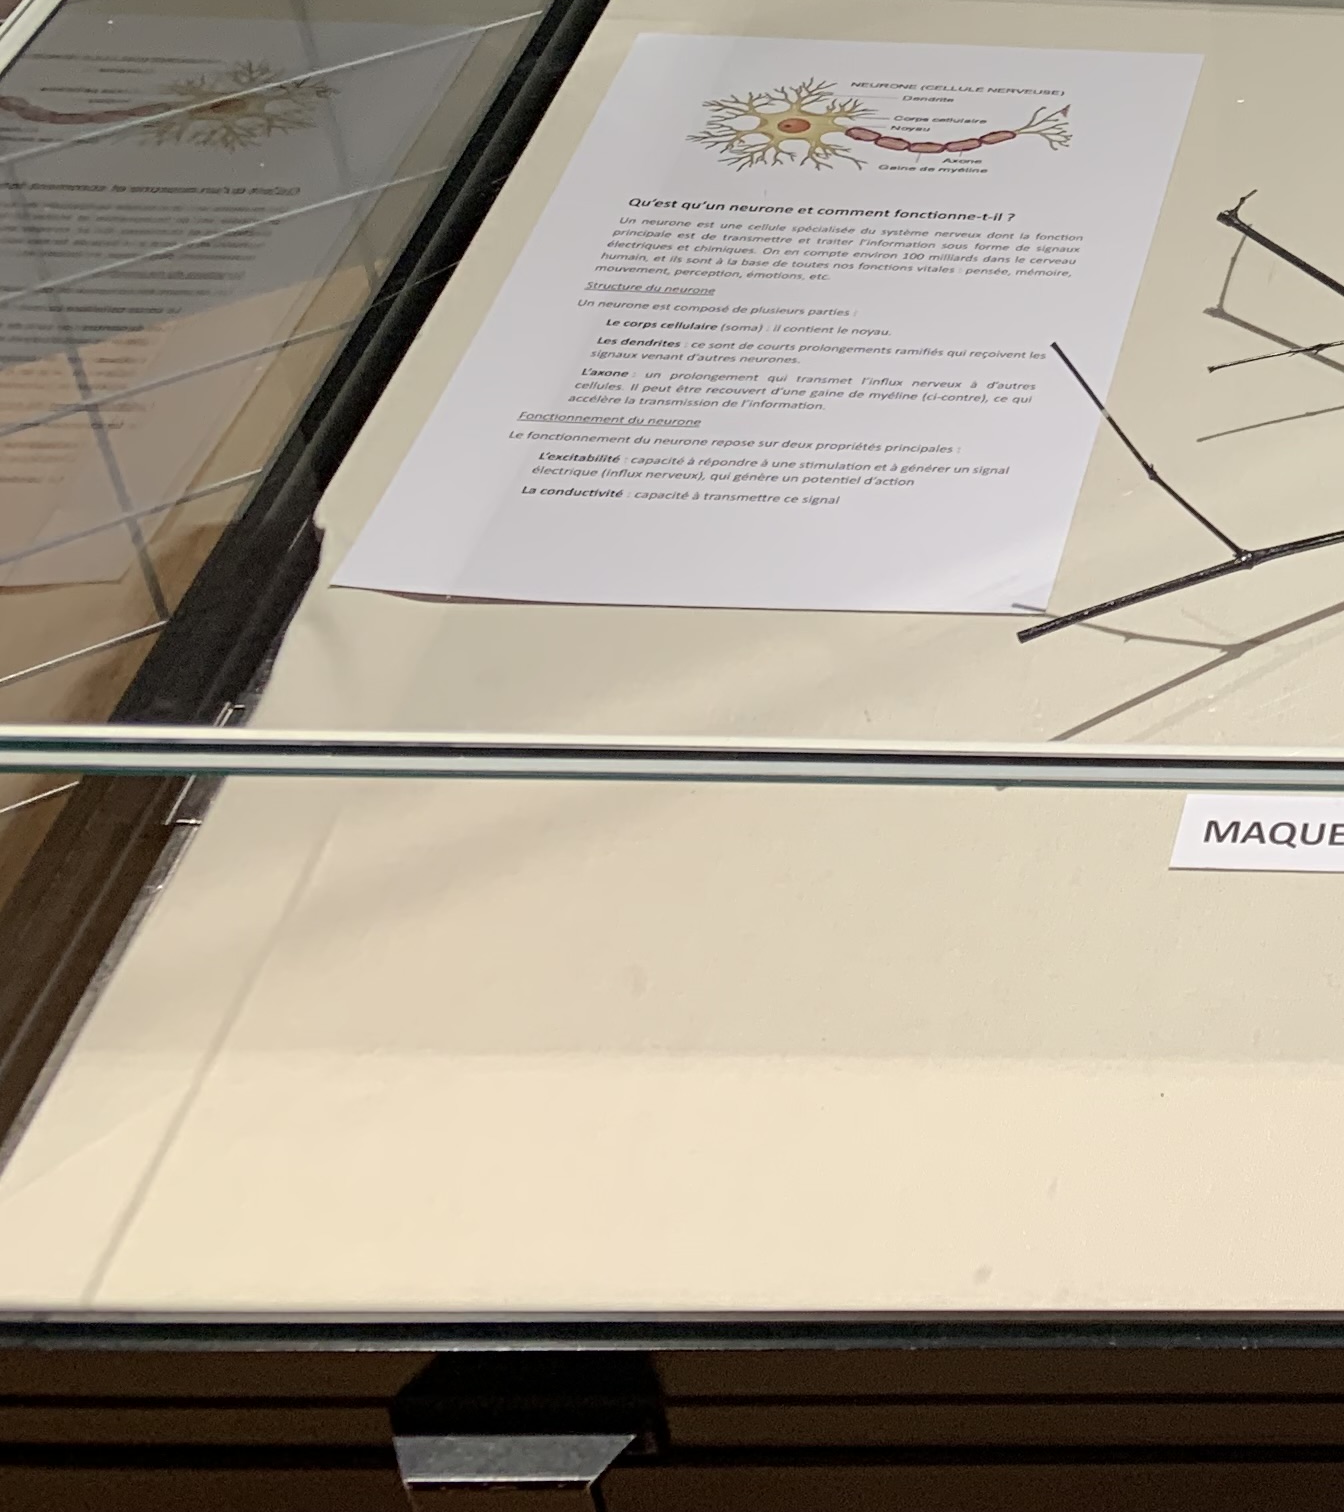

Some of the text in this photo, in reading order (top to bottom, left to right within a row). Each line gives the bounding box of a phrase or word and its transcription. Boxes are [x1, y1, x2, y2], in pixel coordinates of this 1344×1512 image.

[628, 197, 1016, 222] Qu'est qu'un neurone et comment fonctionne-t-il ?
[618, 216, 637, 224] Un
[640, 219, 692, 227] neurone
[747, 223, 787, 232] cellule
[791, 225, 856, 234] spécialisée
[860, 227, 876, 235] du
[880, 228, 929, 237] système
[986, 231, 1014, 240] dont
[1019, 232, 1030, 240] la
[1035, 232, 1084, 241] fonction
[606, 239, 673, 251] électriques
[676, 244, 690, 252] et
[693, 244, 758, 255] chimiques.
[762, 247, 780, 255] On
[803, 250, 849, 258] compte
[852, 251, 898, 259] environ
[902, 252, 925, 261] 100
[928, 253, 978, 262] milliards
[982, 255, 1011, 264] dans
[1014, 255, 1026, 264] le
[1029, 257, 1077, 265] cerveau
[586, 281, 716, 294] Structure du neurone
[577, 298, 850, 317] Un neurone est composé de plusieurs parties
[605, 318, 891, 337] Le corps cellulaire (soma) il contient le noyau.
[517, 411, 625, 423] Fonctionnement
[627, 415, 645, 423] du
